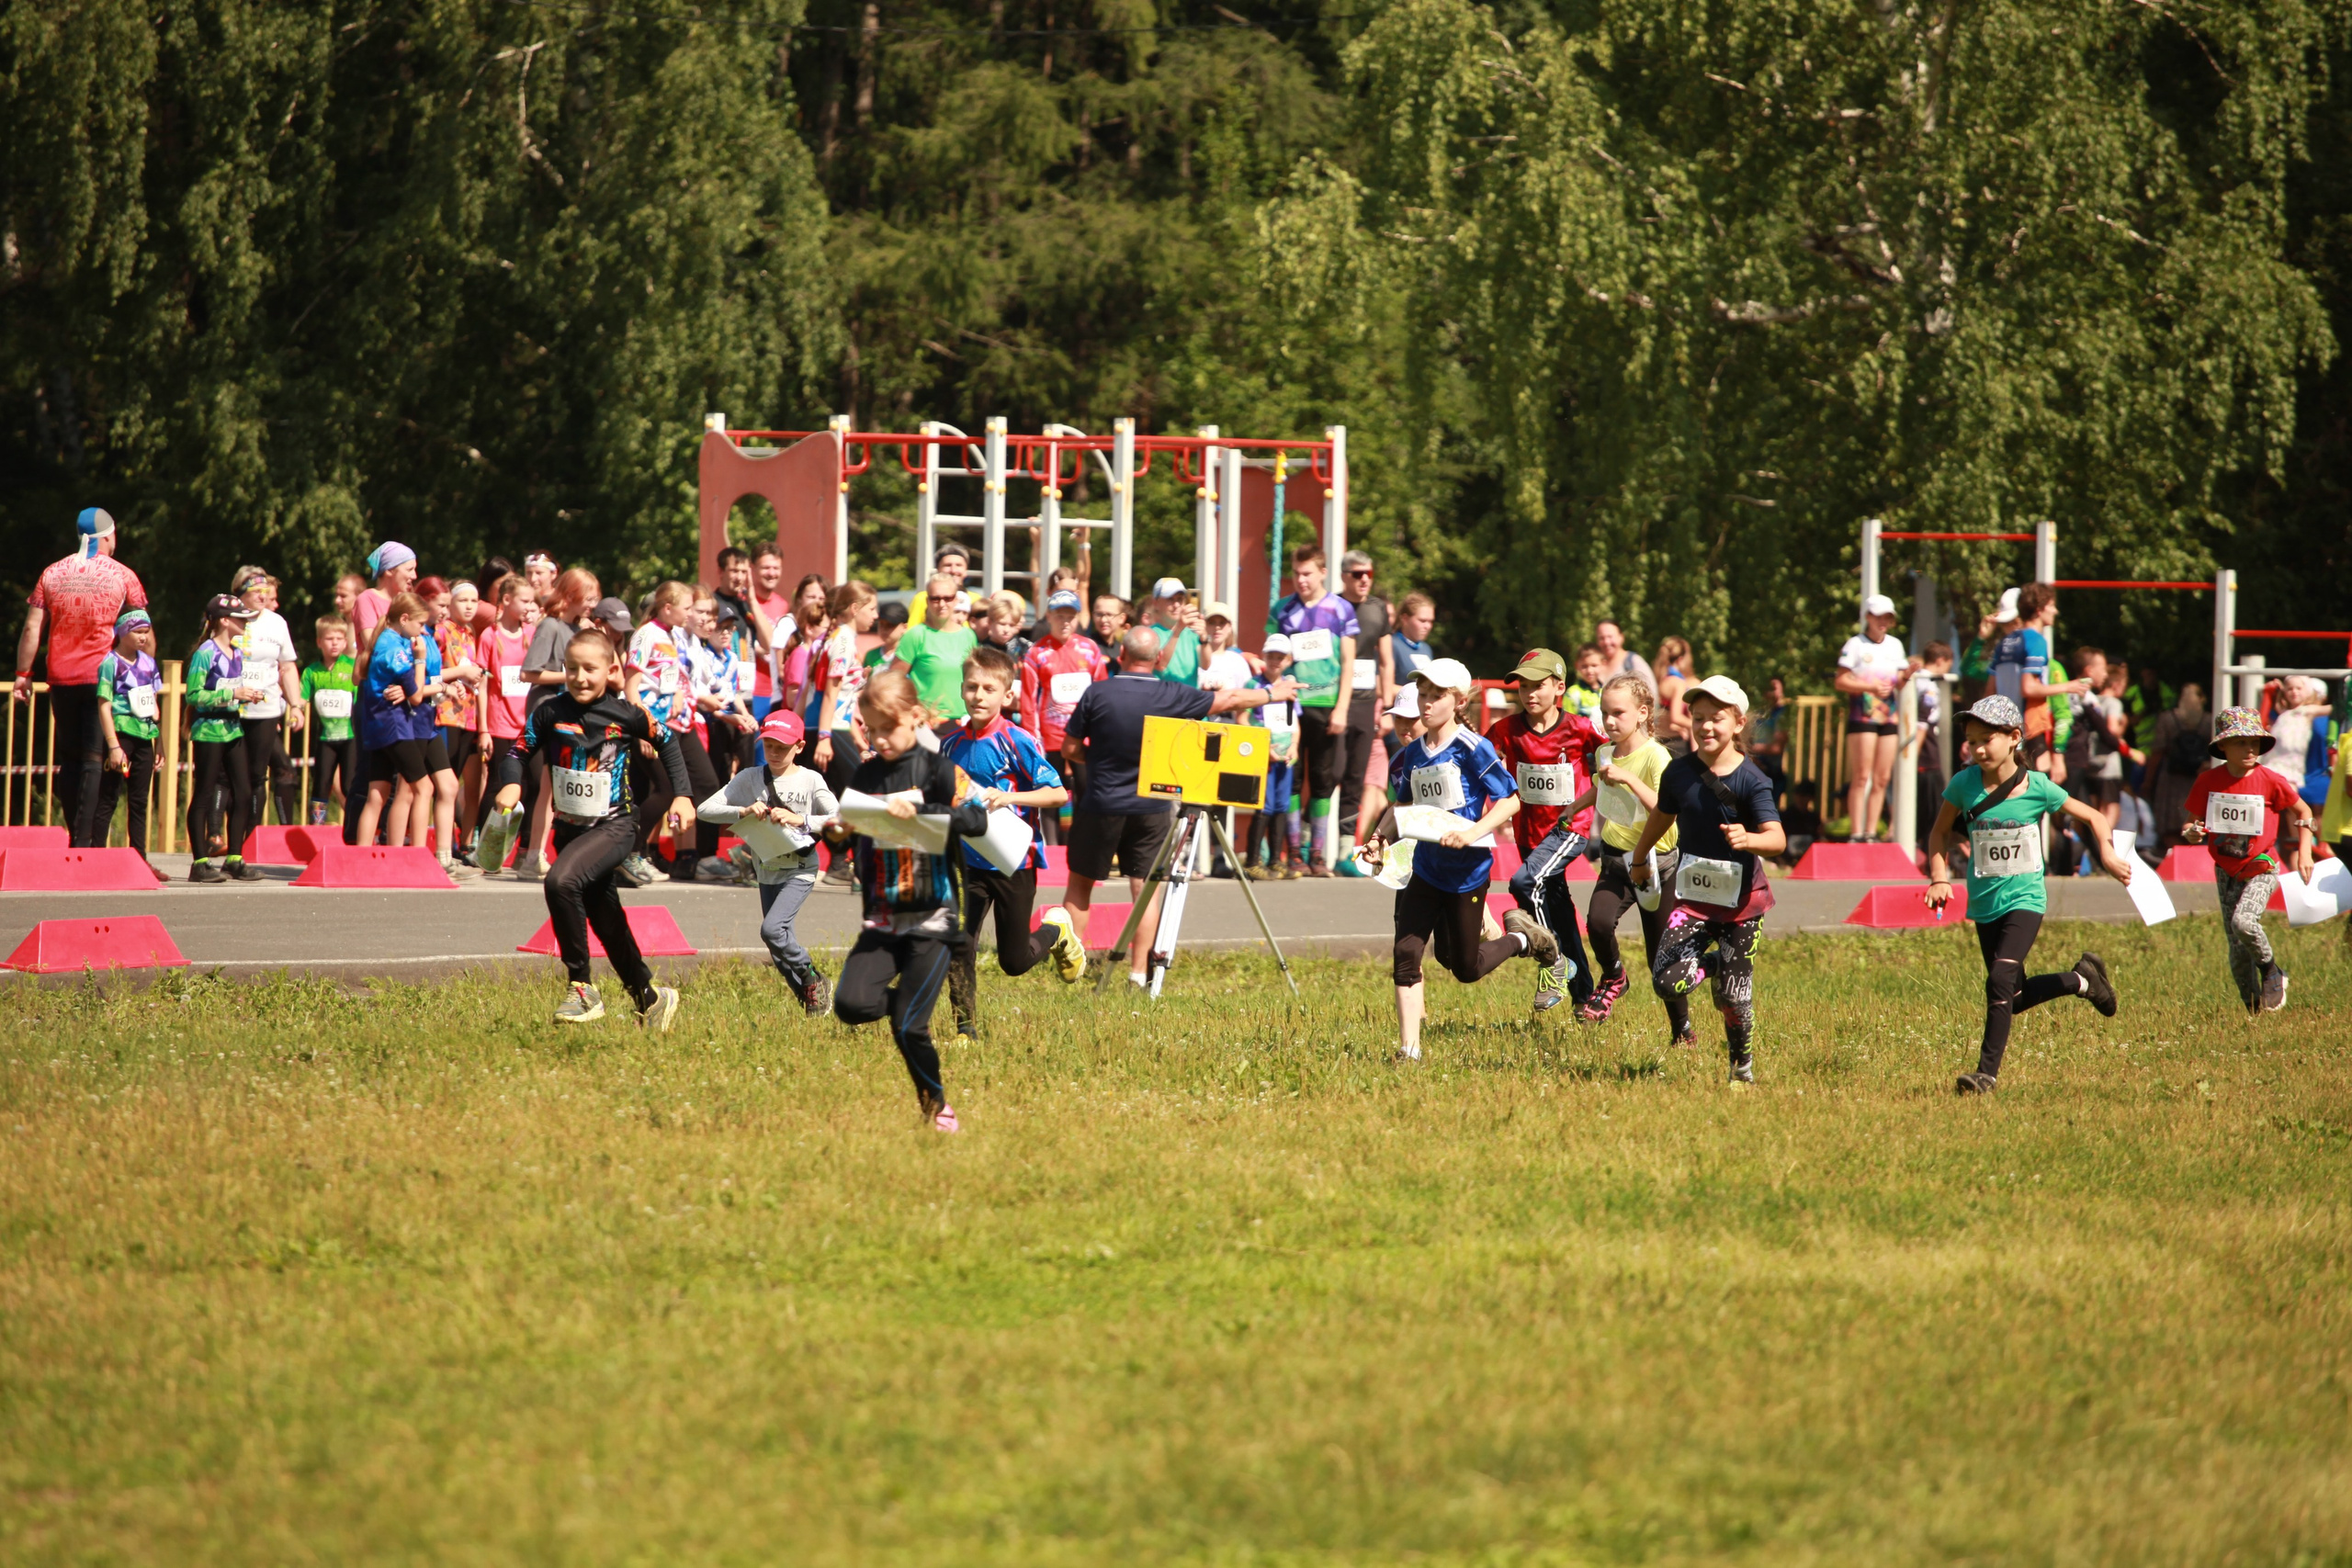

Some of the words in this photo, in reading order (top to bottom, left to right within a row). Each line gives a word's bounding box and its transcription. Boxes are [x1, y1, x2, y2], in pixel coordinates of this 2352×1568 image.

[243, 671, 259, 681] 926
[141, 696, 153, 706] 672
[322, 699, 340, 708] 652
[566, 782, 594, 797] 603
[1420, 782, 1442, 798] 610
[1528, 776, 1555, 791] 606
[2222, 807, 2246, 822] 601
[1989, 845, 2021, 861] 607
